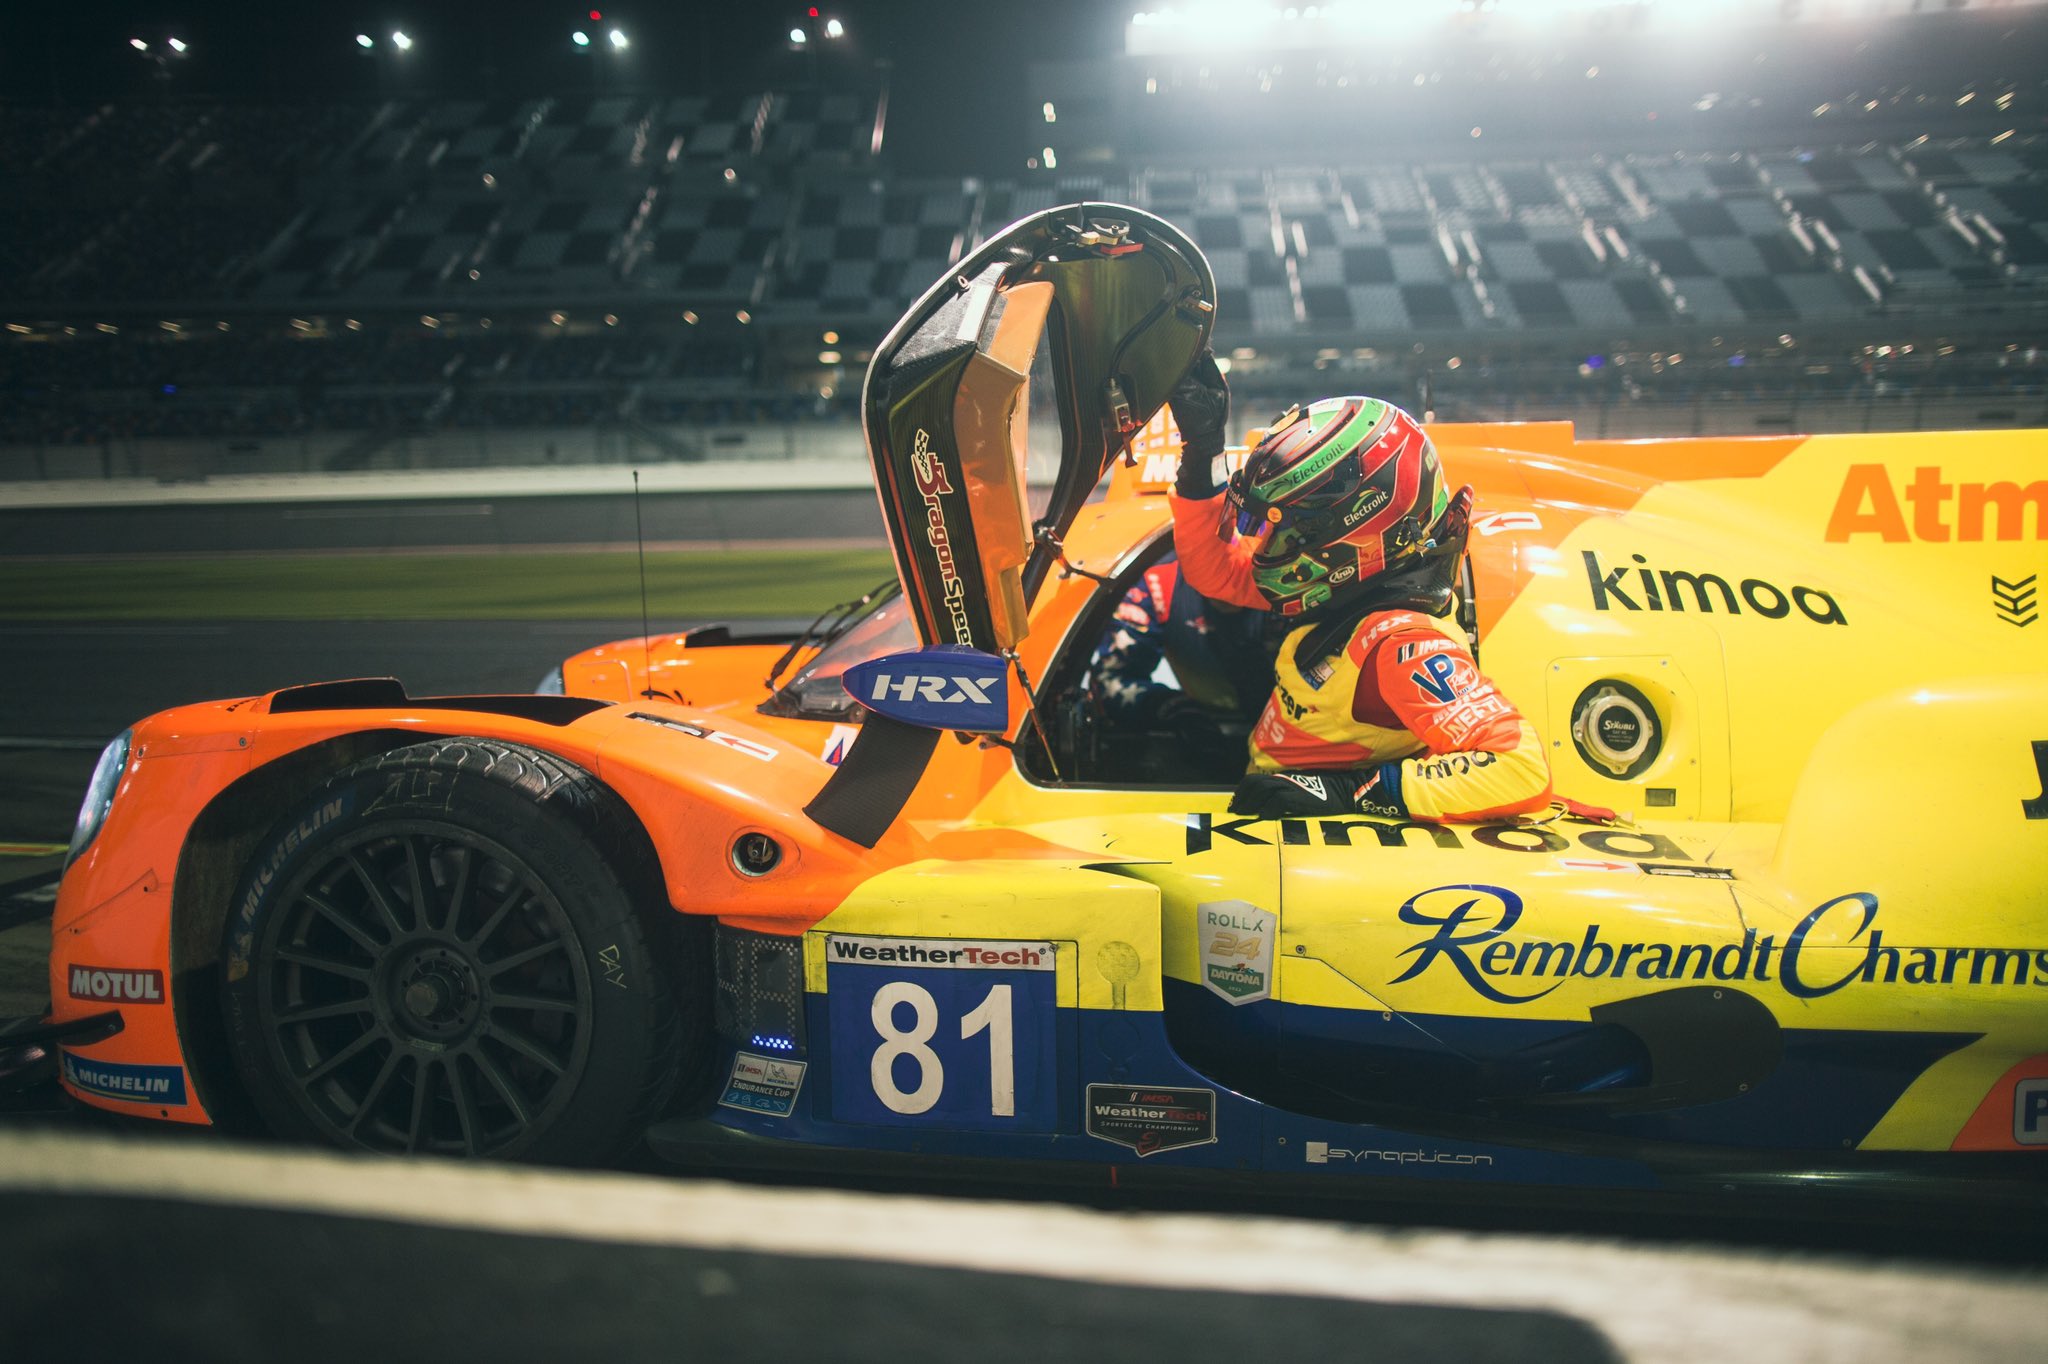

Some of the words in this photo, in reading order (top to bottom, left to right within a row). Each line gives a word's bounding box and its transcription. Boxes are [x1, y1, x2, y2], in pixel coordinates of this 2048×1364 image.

[1292, 442, 1346, 484] Electrolit
[1343, 490, 1389, 526] Electrolit
[911, 452, 974, 648] DragonSpee
[1581, 550, 1848, 625] kimoa
[1361, 613, 1413, 650] HRX
[871, 674, 999, 704] HRX
[1410, 653, 1456, 704] VP
[1187, 813, 1694, 861] kimoa
[240, 797, 343, 923] MICHELIN
[1209, 931, 1262, 960] 24
[1387, 883, 1774, 1004] Rembrandt
[72, 969, 160, 999] MOTUL
[1210, 968, 1260, 986] DAYTONA
[871, 981, 1015, 1117] 81
[79, 1068, 170, 1093] MICHELIN
